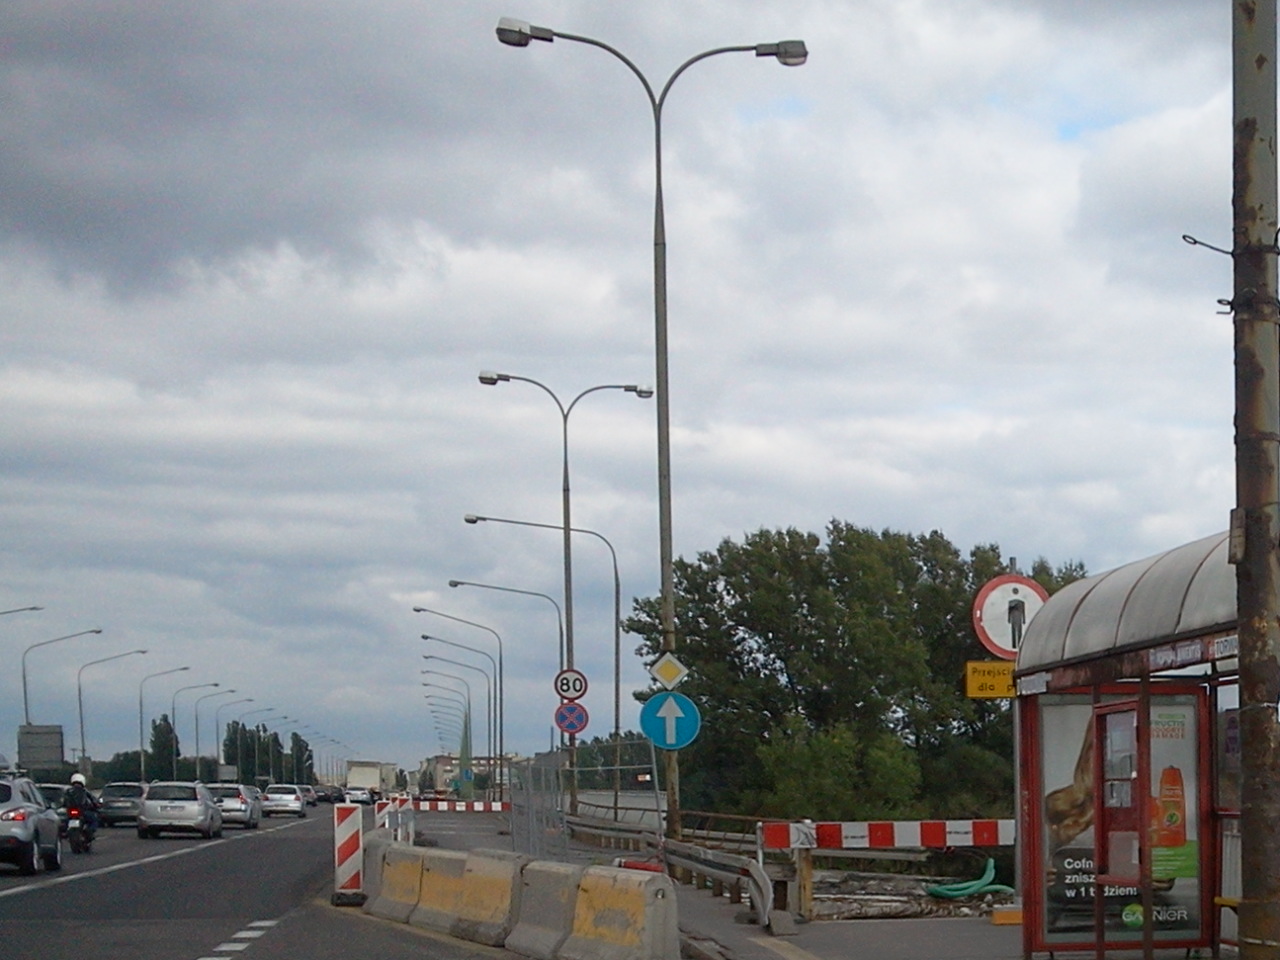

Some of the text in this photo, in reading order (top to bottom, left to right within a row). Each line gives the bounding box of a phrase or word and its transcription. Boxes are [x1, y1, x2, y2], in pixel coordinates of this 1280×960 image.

[560, 676, 583, 693] 80
[1064, 858, 1094, 870] Cofn
[1064, 873, 1096, 884] znisz
[1065, 889, 1077, 897] w
[1122, 909, 1188, 921] GANIER
